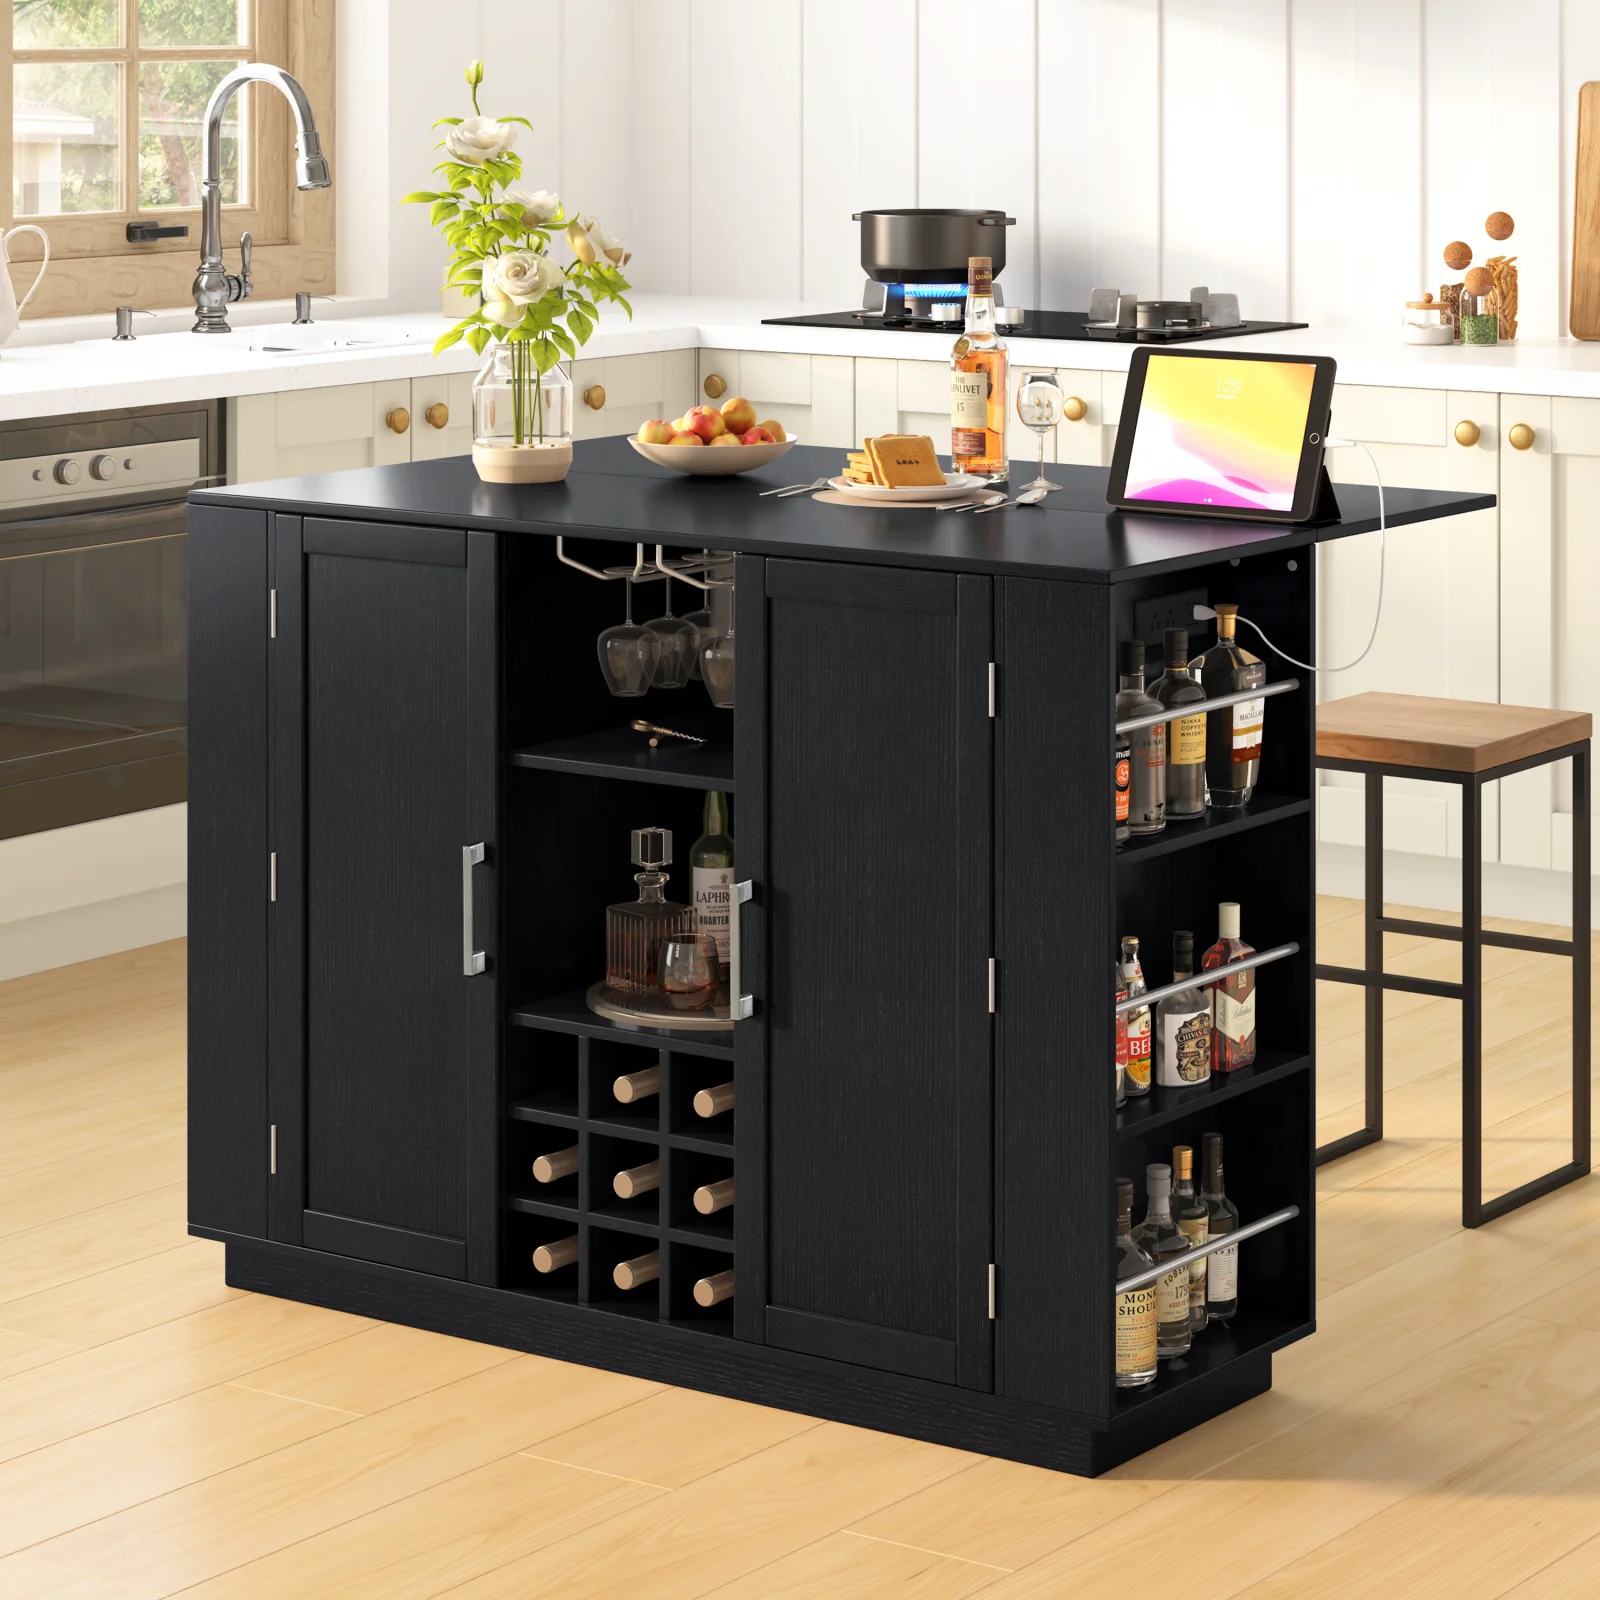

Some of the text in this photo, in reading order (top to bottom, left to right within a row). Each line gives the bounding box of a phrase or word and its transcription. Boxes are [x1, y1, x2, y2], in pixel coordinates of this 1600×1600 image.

[955, 376, 965, 385] THE
[1216, 378, 1242, 394] 1:29
[957, 402, 964, 412] 15
[1239, 709, 1264, 721] MACALLAN
[1180, 730, 1204, 738] WHISKY
[700, 915, 729, 925] QUARTER
[1177, 1028, 1204, 1043] CHIVAS
